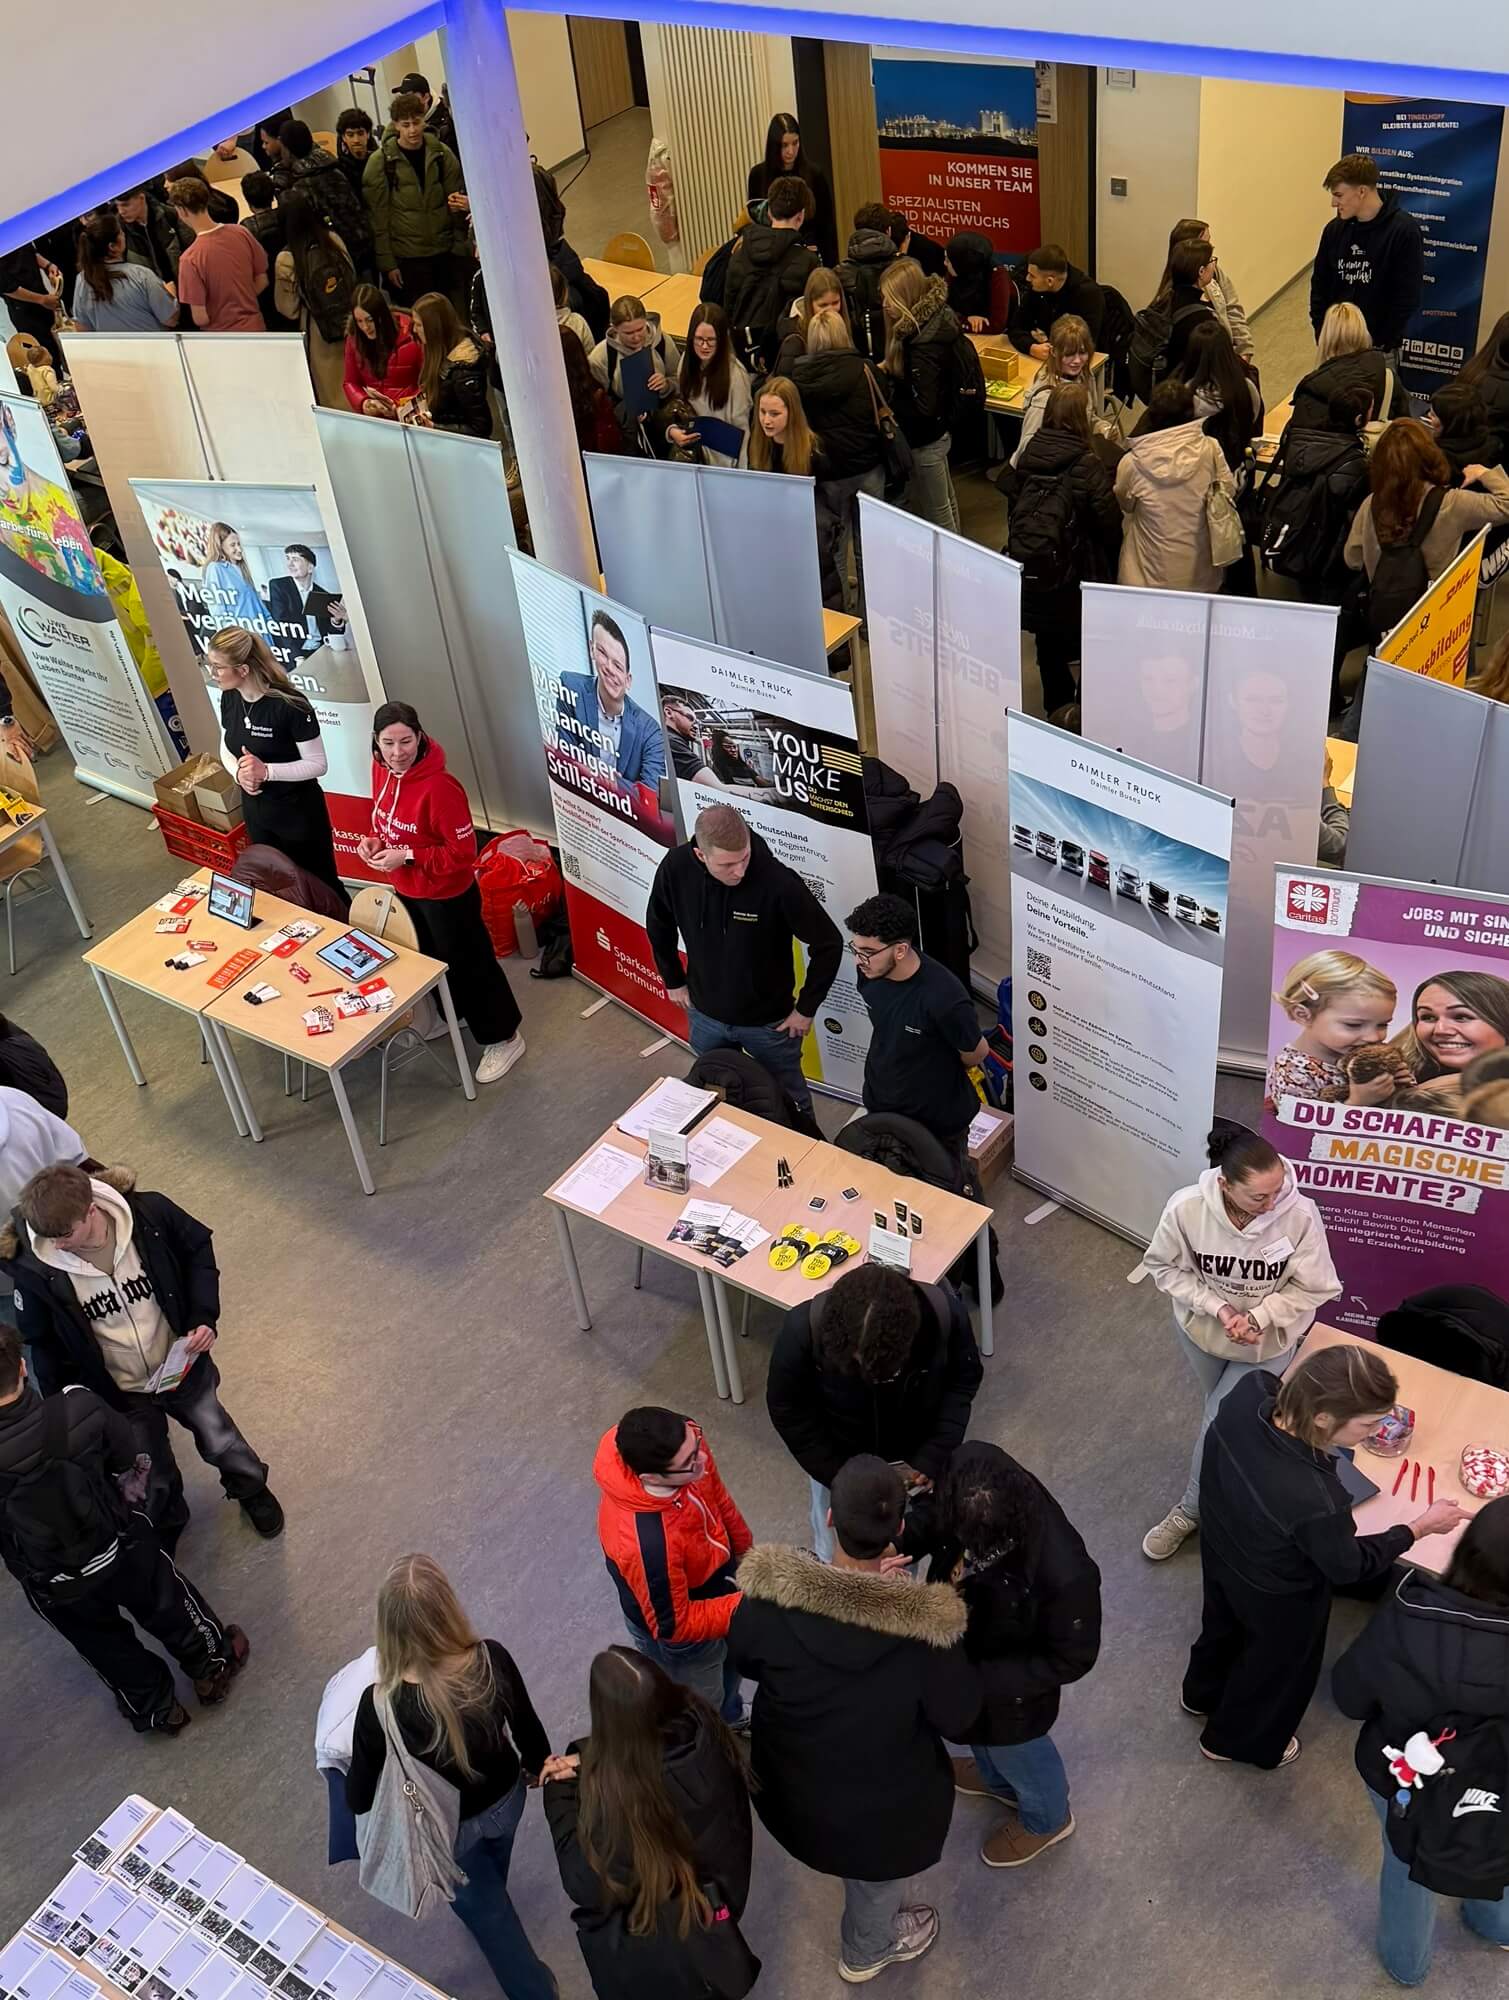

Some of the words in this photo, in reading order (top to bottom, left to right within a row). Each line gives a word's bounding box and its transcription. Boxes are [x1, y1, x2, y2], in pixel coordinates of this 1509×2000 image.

[1356, 146, 1370, 154] WIR
[1371, 147, 1397, 156] BILDEN
[1398, 150, 1415, 158] AUS:
[929, 174, 942, 187] IN
[946, 175, 991, 190] UNSER
[994, 179, 1033, 193] TEAM
[947, 161, 1007, 176] KOMMEN
[1011, 166, 1033, 179] SIE
[1380, 171, 1406, 179] rmatiker
[1407, 173, 1463, 186] Systemintegration
[888, 195, 981, 212] SPEZIALISTEN
[923, 210, 1010, 229] NACHWUCHS
[1424, 238, 1478, 252] ungsentwicklung
[0, 519, 25, 534] arbe
[177, 581, 239, 610] Mehr
[36, 620, 91, 647] WALTER
[47, 618, 67, 629] UWE
[187, 610, 312, 640] verändern.
[1414, 611, 1472, 676] usbildung
[531, 662, 579, 707] Mehr
[711, 665, 756, 686] DAIMLER
[760, 680, 793, 697] TRUCK
[730, 681, 755, 694] Daimler
[756, 688, 776, 700] Buses
[539, 695, 621, 759] Chancen.
[541, 723, 623, 782] Weniger
[765, 727, 820, 764] YOU
[772, 752, 841, 792] MAKE
[1070, 759, 1120, 786] DAIMLER
[1126, 781, 1162, 804] TRUCK
[547, 751, 639, 821] Stillstand.
[774, 775, 810, 804] US
[1090, 778, 1118, 796] Daimler
[1119, 789, 1142, 805] Buses
[834, 799, 849, 809] DEN
[333, 827, 366, 842] kasse
[756, 821, 808, 843] Deutschland
[1026, 891, 1049, 909] Deine
[1330, 887, 1341, 926] dortmund
[1026, 903, 1051, 921] Deine
[1052, 914, 1089, 939] Vorteile.
[1287, 911, 1325, 924] caritas
[1402, 907, 1445, 922] JOBS
[1449, 911, 1479, 926] MIT
[1483, 914, 1509, 930] SIN
[1423, 924, 1460, 940] UND
[1463, 929, 1509, 947] SICHE
[613, 946, 664, 986] Sparkasse
[616, 961, 665, 1000] Dortmund
[1293, 1102, 1336, 1126] DU
[1343, 1109, 1503, 1152] SCHAFFST
[1329, 1138, 1506, 1186] MAGISCHE
[1294, 1163, 1467, 1208] MOMENTE?
[1319, 1205, 1341, 1214] sere
[1343, 1207, 1370, 1218] Kitas
[1371, 1212, 1420, 1225] brauchen
[1422, 1220, 1476, 1237] Menschen
[1362, 1219, 1398, 1231] Bewirb
[1400, 1224, 1424, 1237] Dich
[1425, 1228, 1442, 1239] für
[1442, 1234, 1465, 1244] eine
[1348, 1235, 1364, 1244] als
[1402, 1235, 1467, 1254] Ausbildung
[1194, 1250, 1235, 1278] NEW
[1461, 1787, 1501, 1806] NIKE
